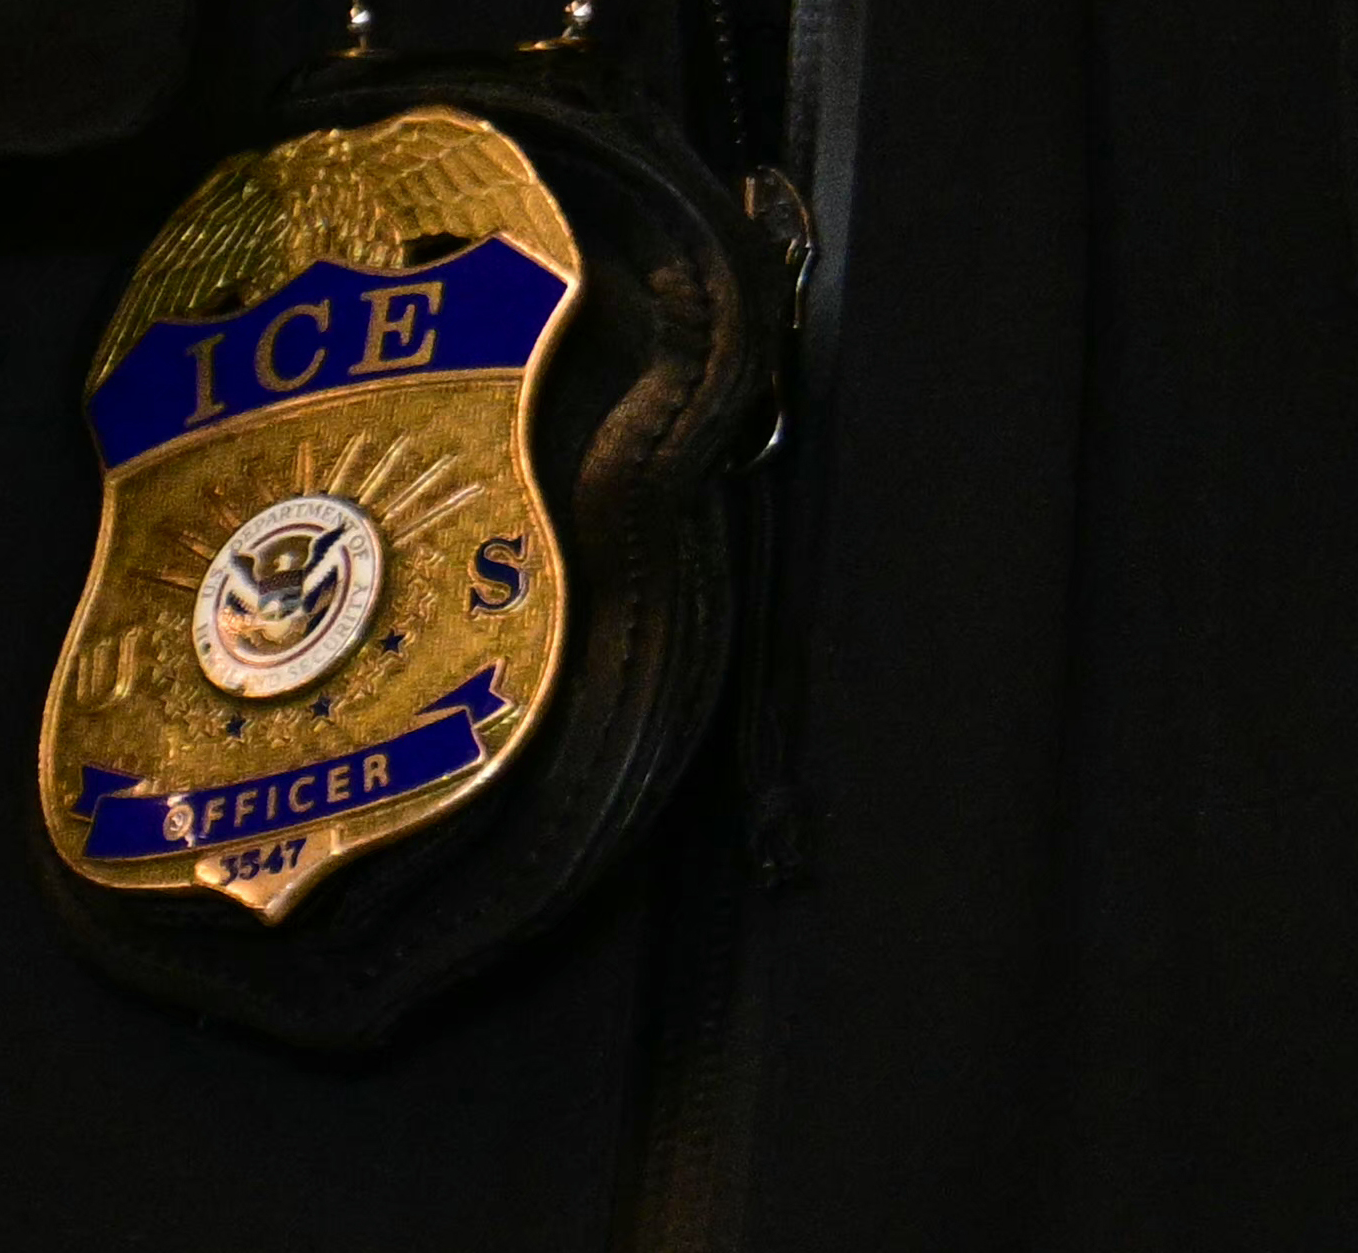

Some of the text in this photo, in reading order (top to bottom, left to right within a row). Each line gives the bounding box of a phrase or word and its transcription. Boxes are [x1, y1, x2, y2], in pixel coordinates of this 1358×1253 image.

[182, 281, 445, 429] ICE
[469, 536, 528, 619] S
[163, 753, 391, 842] OFFICER
